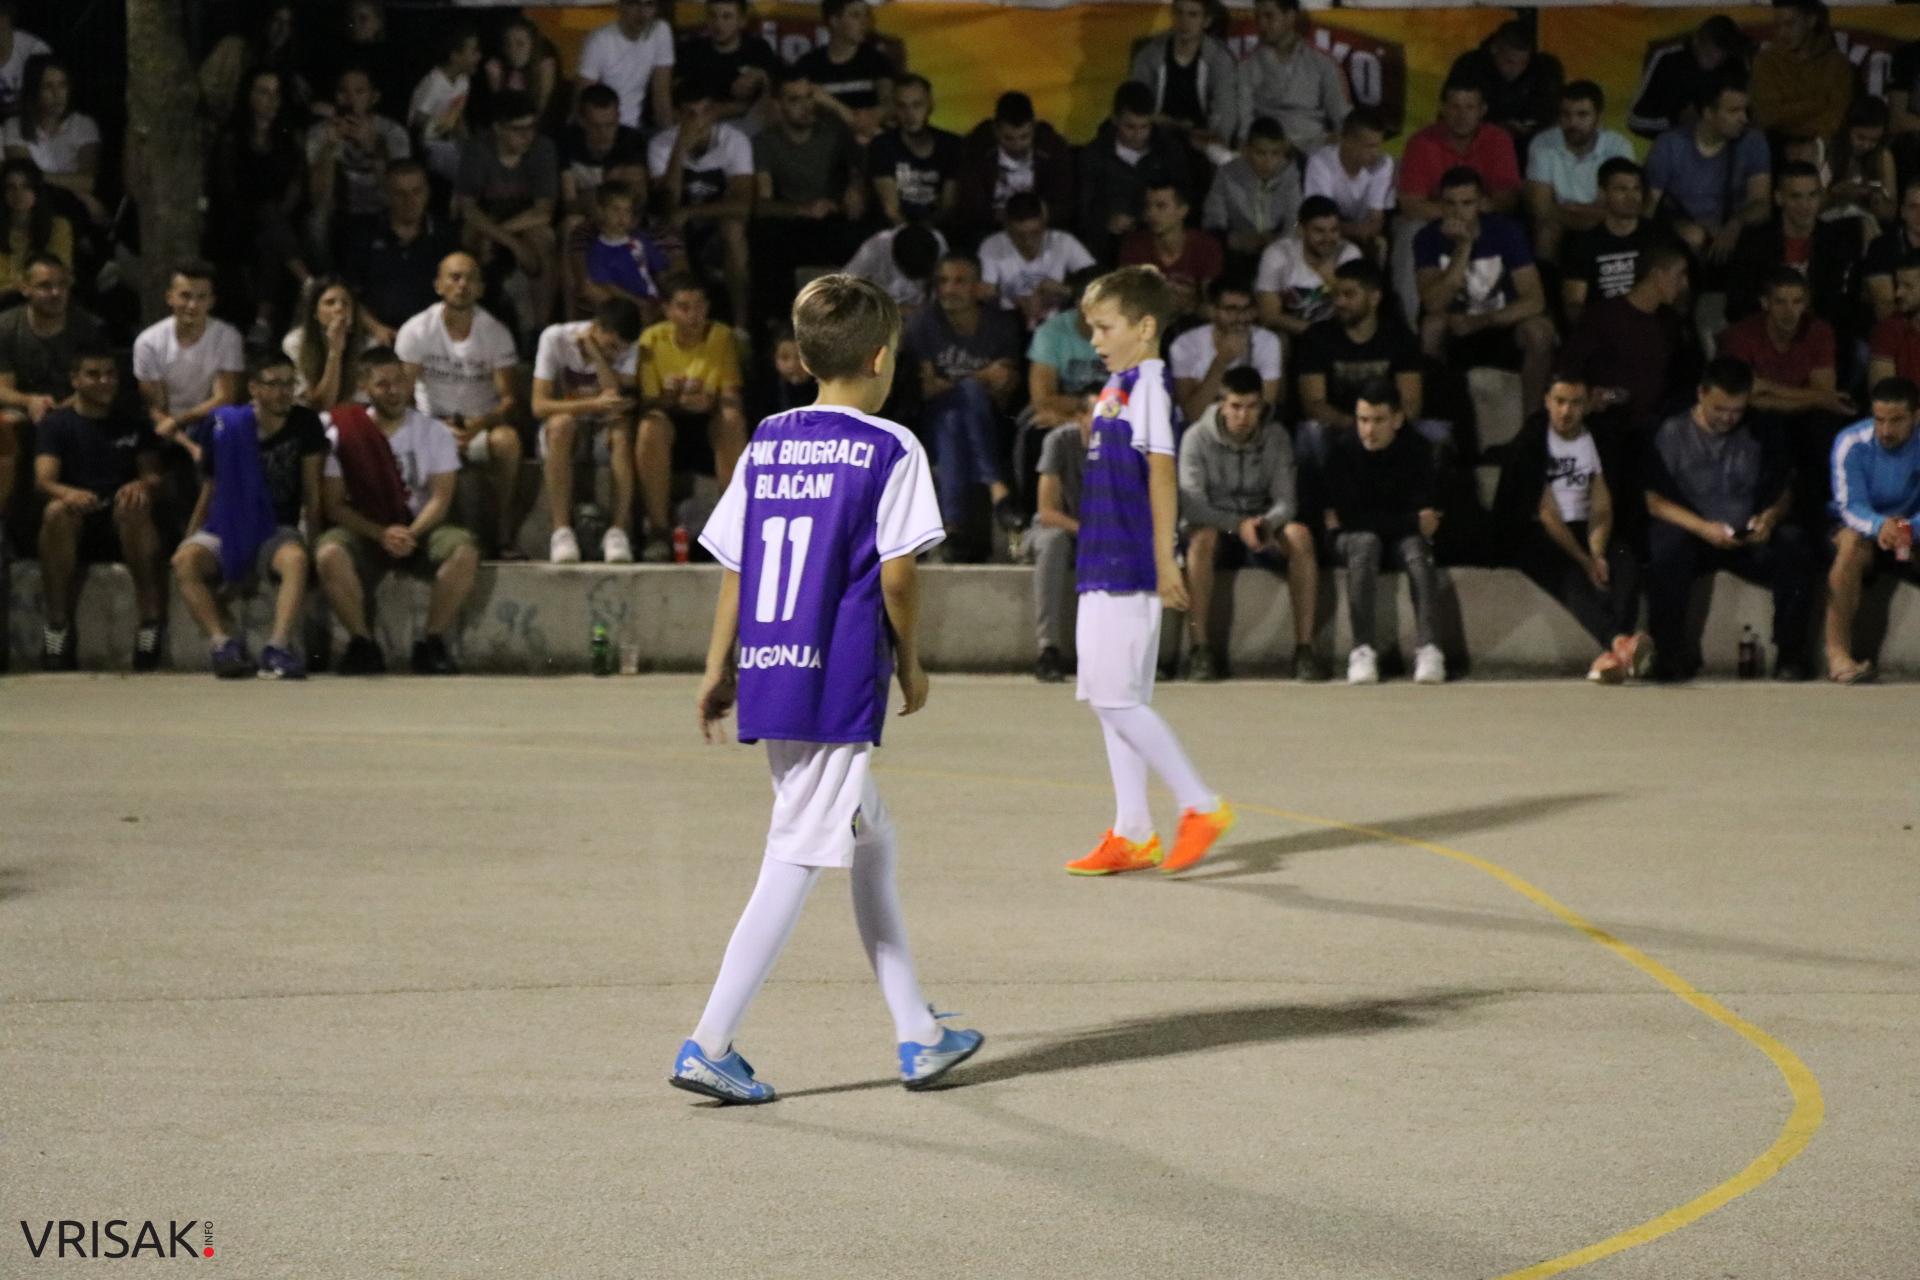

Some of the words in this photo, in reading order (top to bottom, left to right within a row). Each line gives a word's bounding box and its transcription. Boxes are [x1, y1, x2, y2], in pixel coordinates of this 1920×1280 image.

[778, 438, 875, 468] BIOGRACI
[754, 469, 834, 499] BLAĆANI
[756, 516, 813, 623] 11
